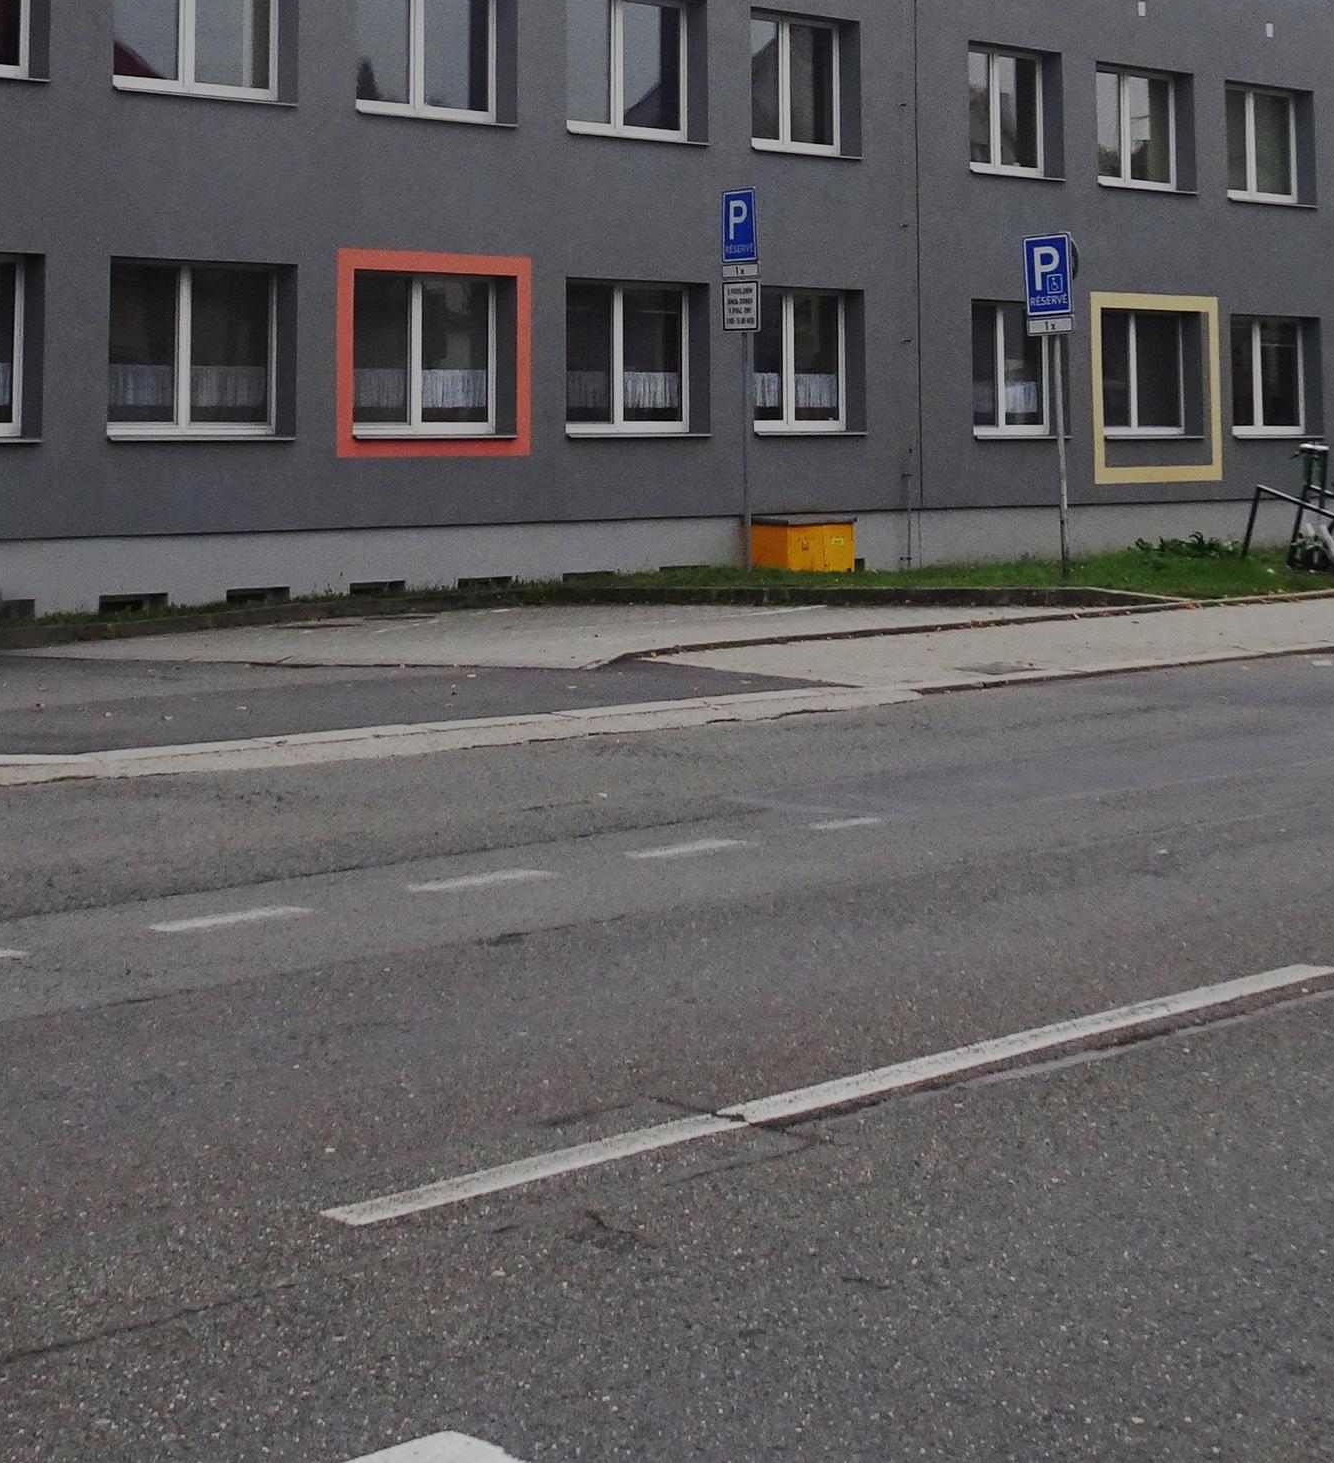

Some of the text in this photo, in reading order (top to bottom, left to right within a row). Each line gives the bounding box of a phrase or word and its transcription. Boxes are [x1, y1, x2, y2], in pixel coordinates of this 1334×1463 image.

[729, 200, 747, 240] P
[1033, 246, 1060, 291] P
[1030, 293, 1069, 306] RÉSERVÉ
